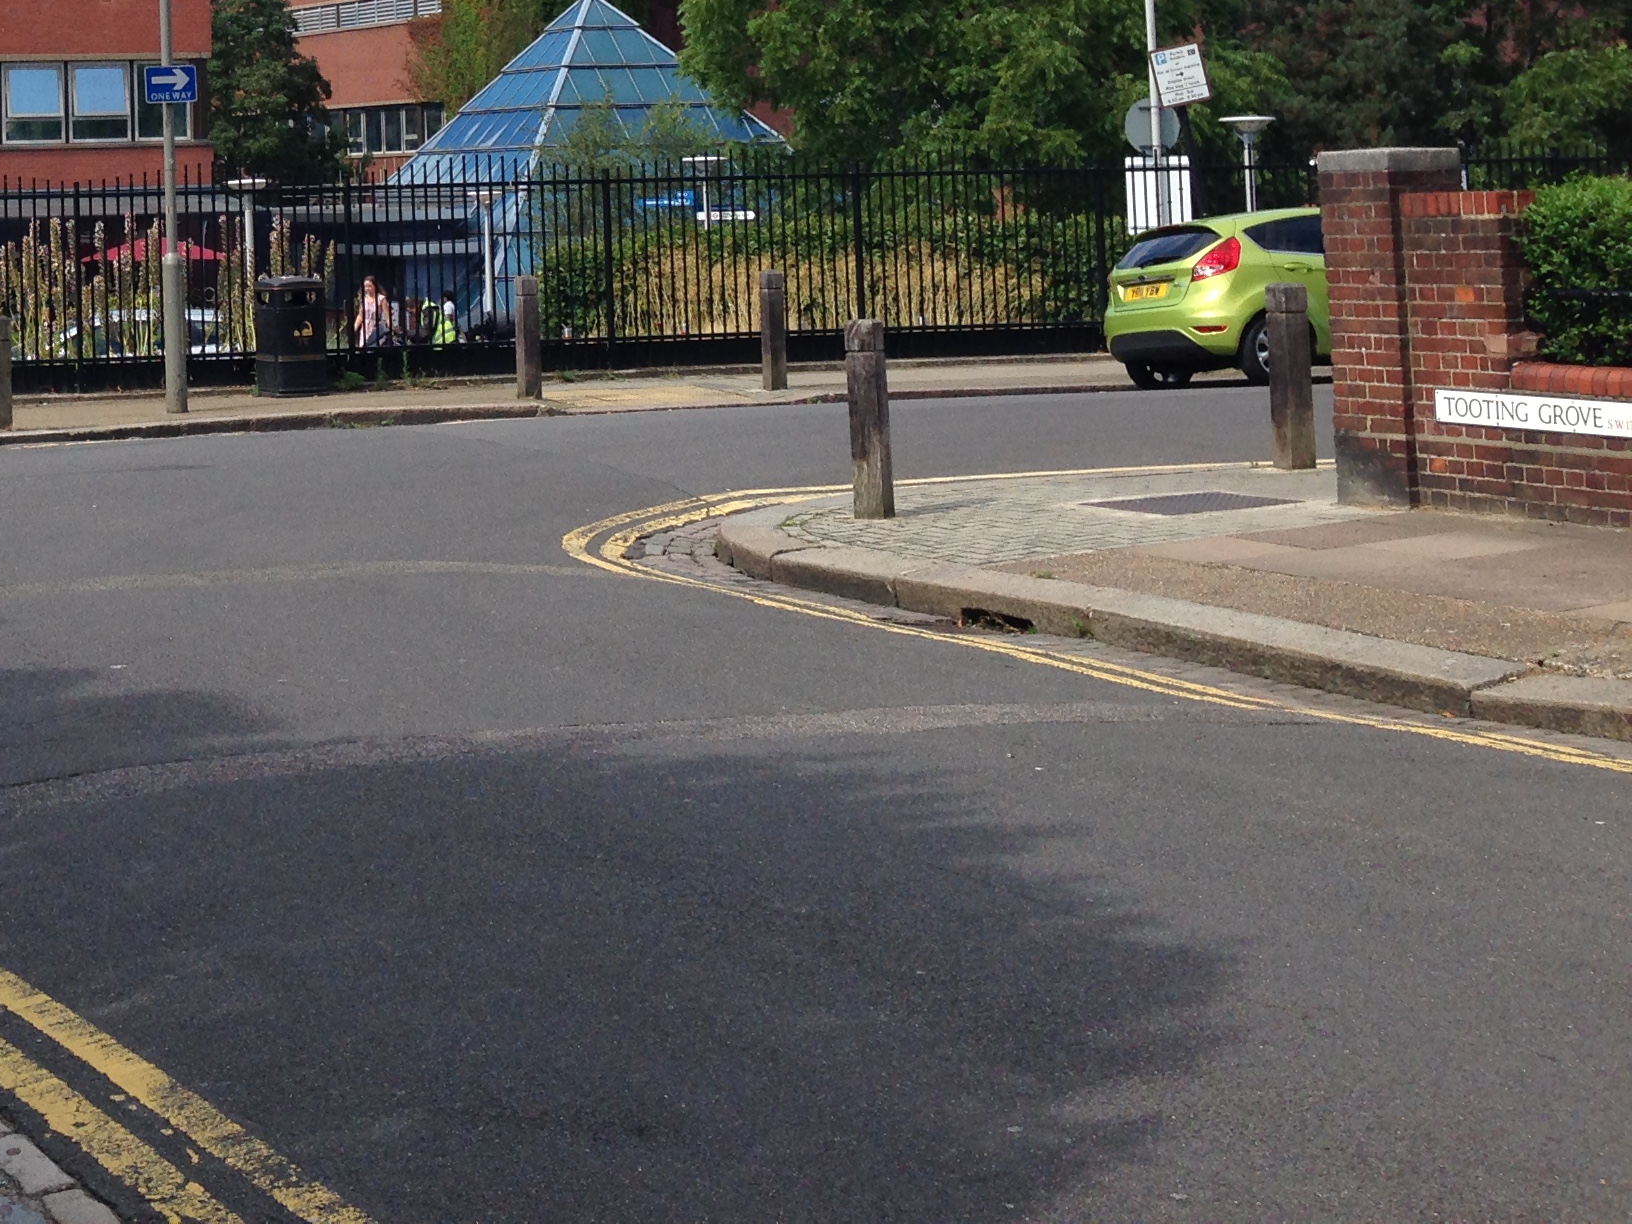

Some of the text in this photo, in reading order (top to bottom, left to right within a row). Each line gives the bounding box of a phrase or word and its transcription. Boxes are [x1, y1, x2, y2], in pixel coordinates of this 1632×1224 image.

[150, 91, 192, 101] ONE WAY
[1443, 396, 1529, 423] TOOTING
[1538, 403, 1604, 428] GROVE
